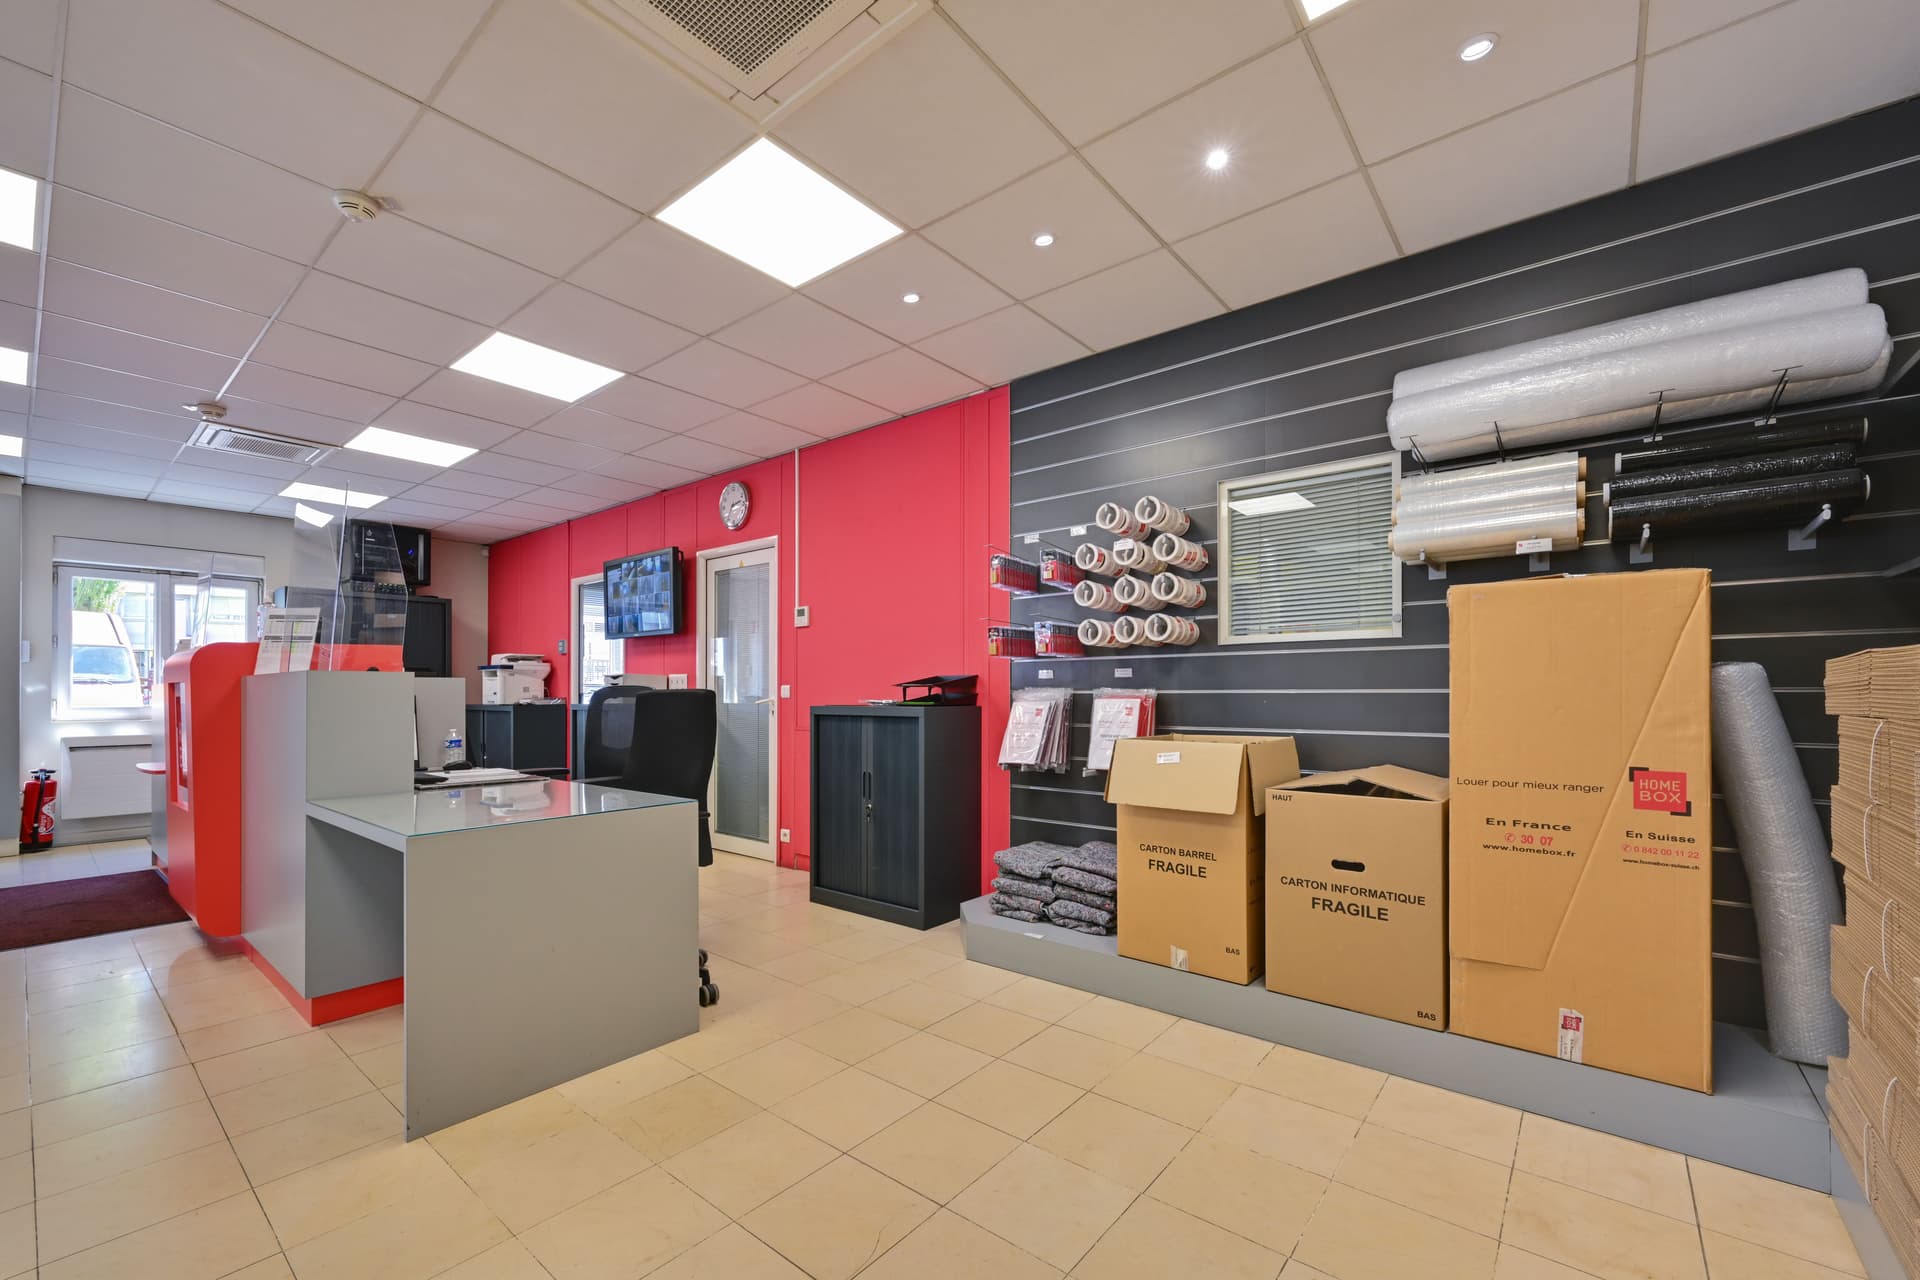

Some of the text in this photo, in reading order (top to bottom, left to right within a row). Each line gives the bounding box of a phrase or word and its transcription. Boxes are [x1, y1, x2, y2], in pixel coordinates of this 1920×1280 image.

[1456, 777, 1605, 793] Louer pour mieux ranger
[1639, 779, 1681, 792] HOME
[1639, 791, 1681, 803] BOX
[1486, 817, 1572, 832] En France
[1521, 835, 1554, 846] 30 07
[1626, 830, 1696, 844] En Suisse
[1140, 843, 1217, 862] CARTON BARREL
[1482, 843, 1577, 857] www.homebox.fr
[1688, 851, 1700, 859] 22
[1148, 859, 1207, 878] FRAGILE
[1280, 876, 1426, 906] CARTON INFORMATIQUE
[1311, 896, 1389, 921] FRAGILE
[1225, 946, 1240, 956] BAS
[1417, 1010, 1437, 1021] BAS
